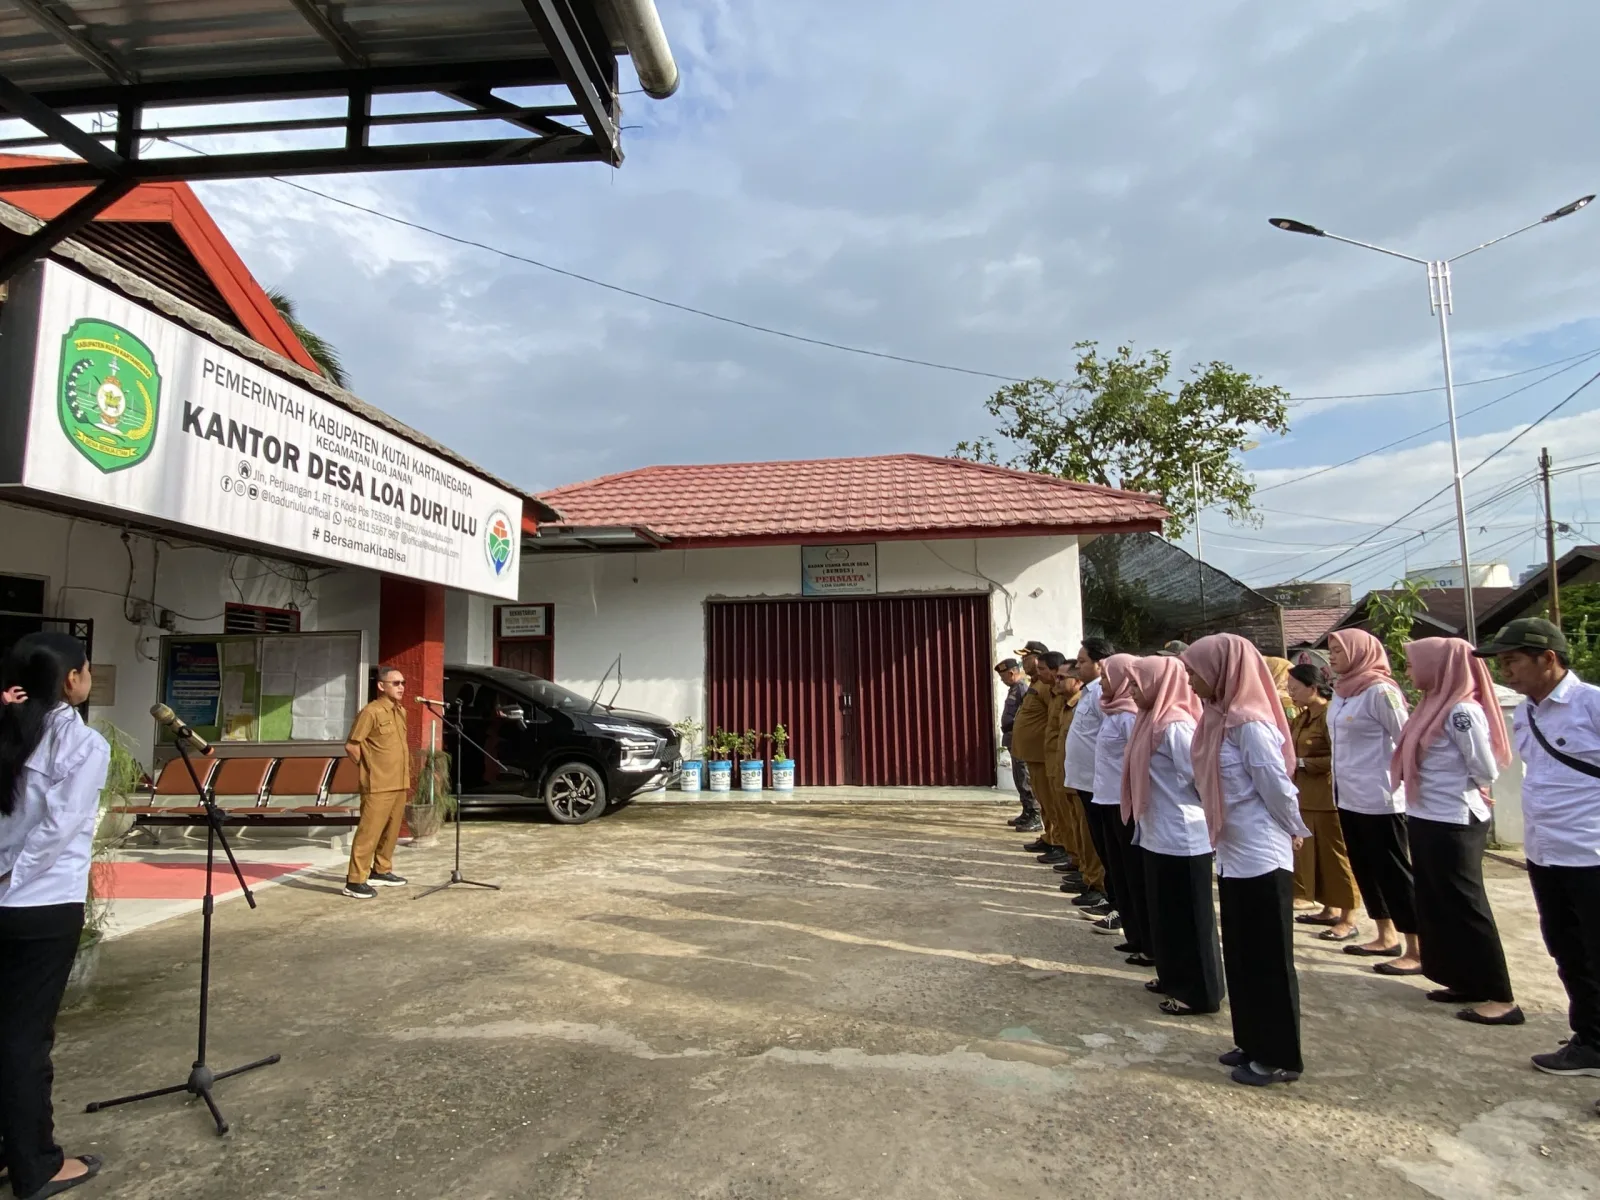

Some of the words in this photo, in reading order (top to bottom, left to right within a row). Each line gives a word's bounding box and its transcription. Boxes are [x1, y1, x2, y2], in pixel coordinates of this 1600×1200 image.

[203, 358, 305, 423] PEMERINTAH
[309, 409, 379, 456] KABUPATEN
[381, 445, 410, 471] KUTAI
[412, 457, 473, 499] KARTANEGARA
[182, 400, 300, 473] KANTOR
[307, 451, 365, 498] DESA
[370, 476, 405, 512] LOA
[410, 493, 448, 527] DURI
[451, 510, 478, 537] ULU
[316, 434, 370, 468] KECAMATAN
[372, 461, 387, 475] LOA
[389, 469, 413, 486] JANAN
[261, 489, 331, 521] @loaduriulu.official
[343, 516, 357, 529] +62
[357, 520, 370, 533] 811
[269, 474, 312, 499] Perjuangan
[334, 497, 339, 508] 5
[340, 500, 357, 513] Kode
[358, 505, 369, 517] Pos
[312, 526, 320, 541] #
[323, 529, 407, 563] BersamaKitaBisa
[815, 574, 865, 583] PERMATA
